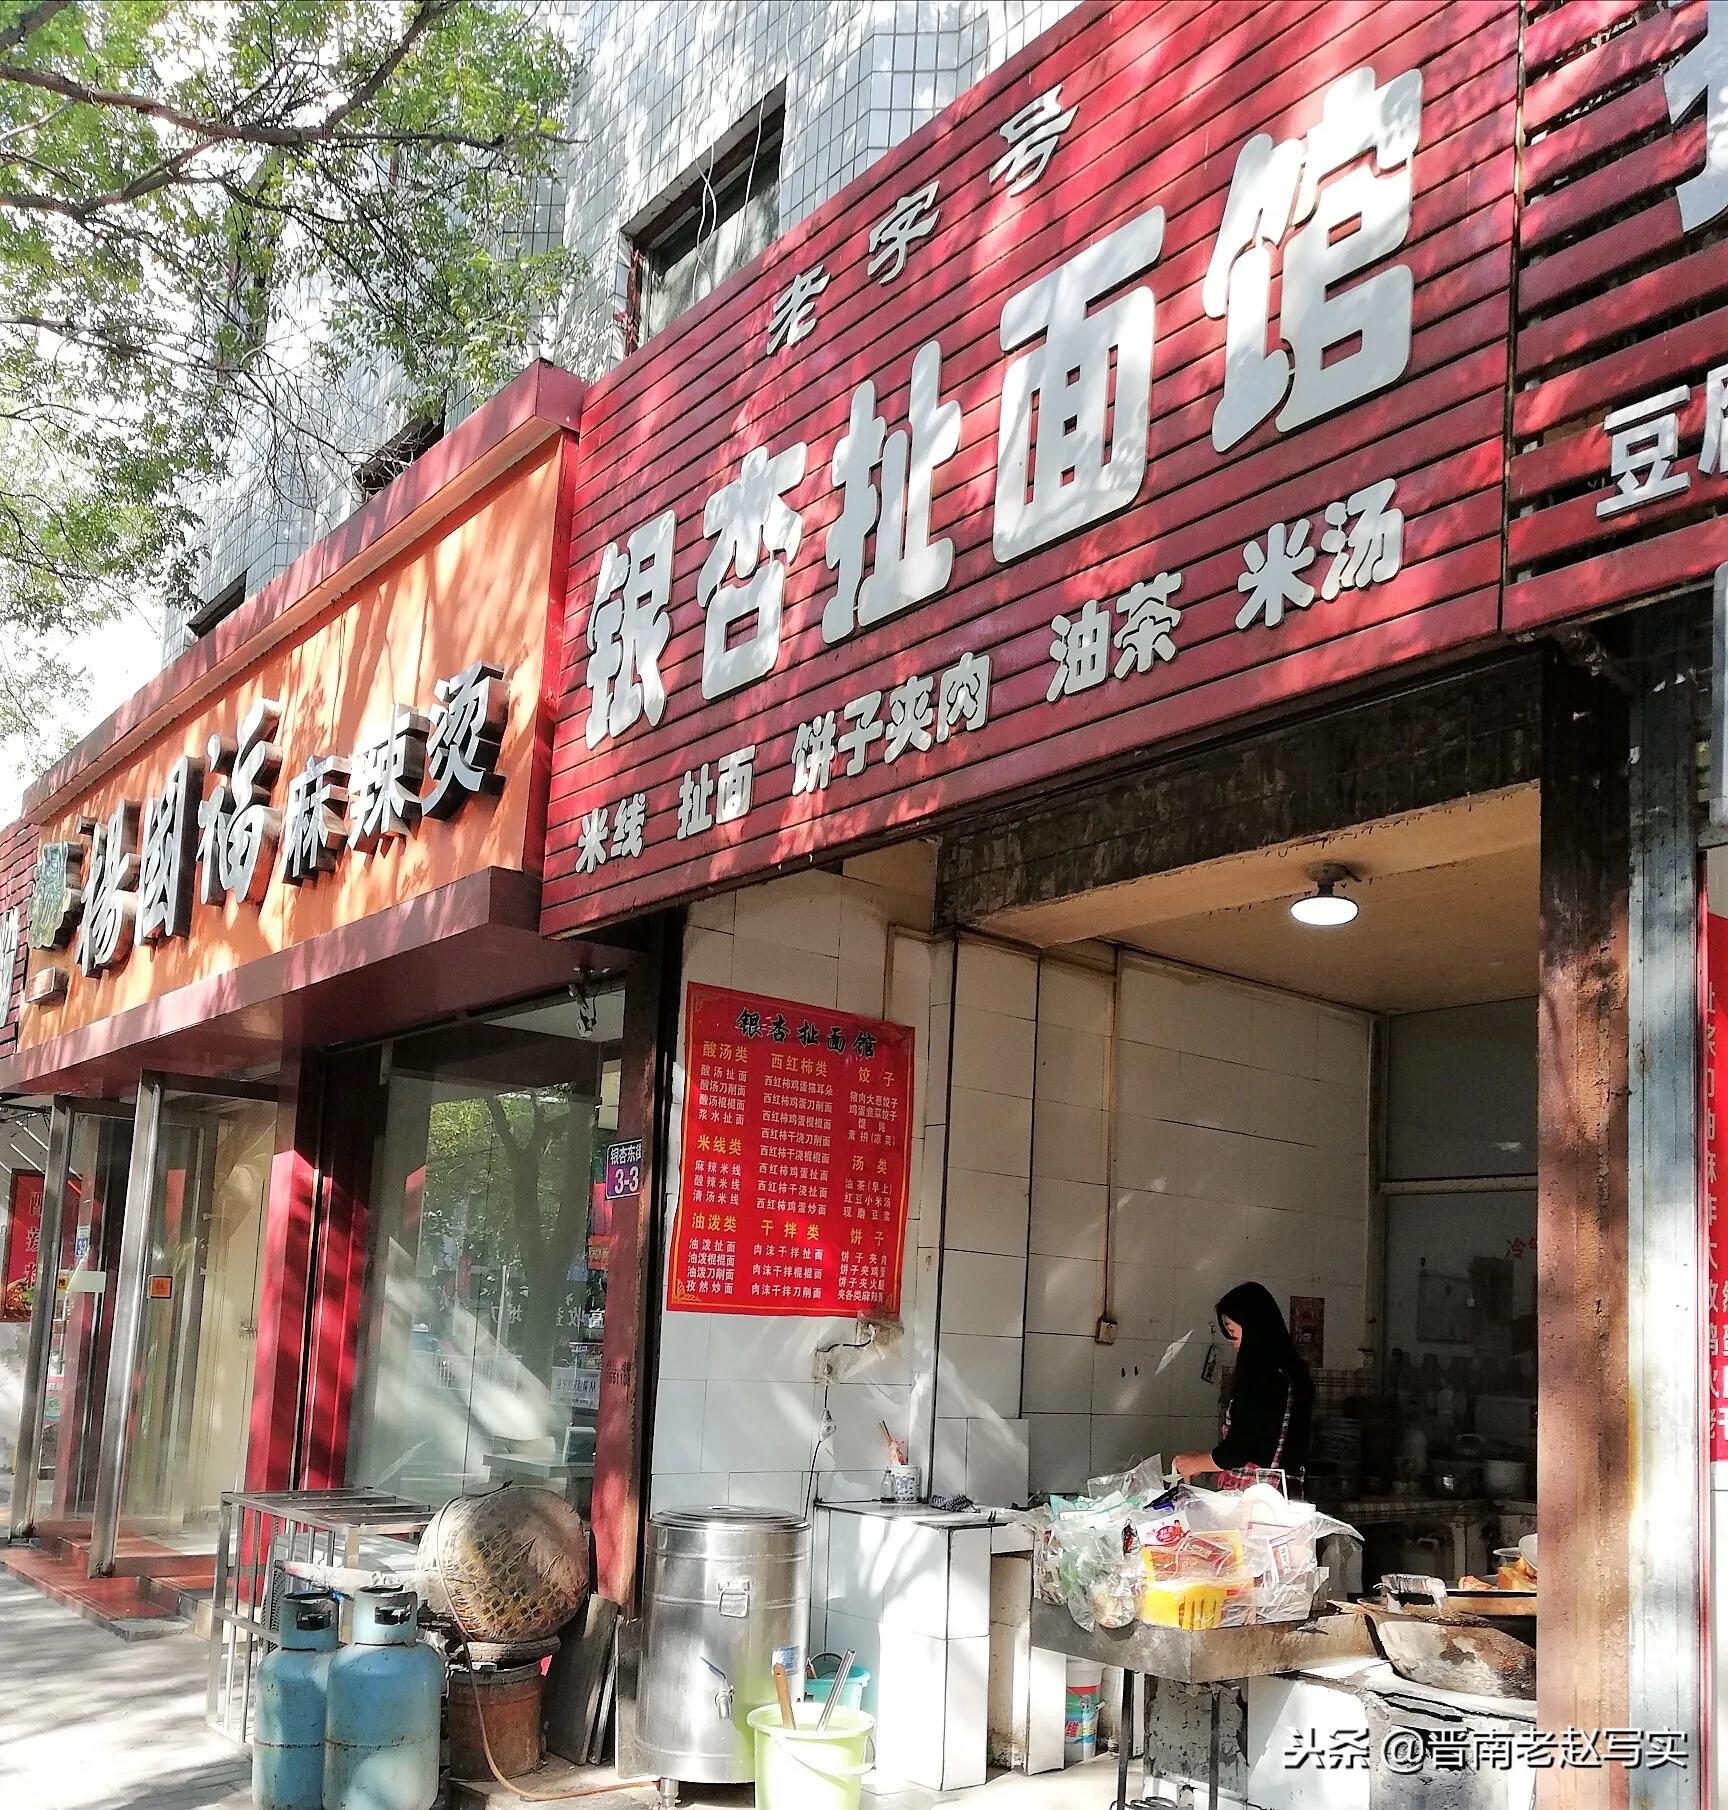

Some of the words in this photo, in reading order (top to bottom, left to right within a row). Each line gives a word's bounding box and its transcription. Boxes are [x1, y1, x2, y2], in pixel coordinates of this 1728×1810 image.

[766, 83, 1080, 356] 老字号
[584, 66, 1424, 751] 银杏扯面馆
[575, 792, 647, 874] 米线
[676, 745, 755, 841] 扯面
[791, 651, 991, 796] 饼子夹肉
[1046, 572, 1183, 702] 油茶
[1235, 478, 1405, 630] 米汤
[736, 1006, 878, 1059] 银杏扯面馆
[702, 1040, 748, 1063] 酸汤类
[701, 1064, 747, 1083] 酸汤扯面
[771, 1053, 828, 1078] 西红柿类
[858, 1066, 895, 1087] 饺子
[700, 1079, 746, 1097] 酸汤刀削面
[763, 1092, 833, 1114] 西红柿鸡蛋刀削面
[698, 1108, 744, 1126] 浆水扯面
[697, 1134, 742, 1155] 米线类
[694, 1159, 741, 1177] 麻辣米线
[758, 1162, 829, 1182] 西红柿鸡蛋扯面
[852, 1154, 887, 1174] 汤类
[614, 1165, 639, 1194] 3-3
[694, 1174, 740, 1191] 酸辣米线
[693, 1189, 739, 1206] 清汤米线
[756, 1197, 827, 1216] 西红柿鸡蛋炒面
[843, 1192, 891, 1208] 红豆小米汤
[691, 1212, 737, 1232] 油泼类
[761, 1219, 820, 1241] 干拌类
[689, 1238, 736, 1254] 油泼扯面
[850, 1228, 884, 1246] 饼子
[753, 1243, 824, 1261] 肉沫干拌扯面
[686, 1280, 734, 1296] 孜然炒面
[751, 1282, 822, 1299] 肉沫干拌刀削面
